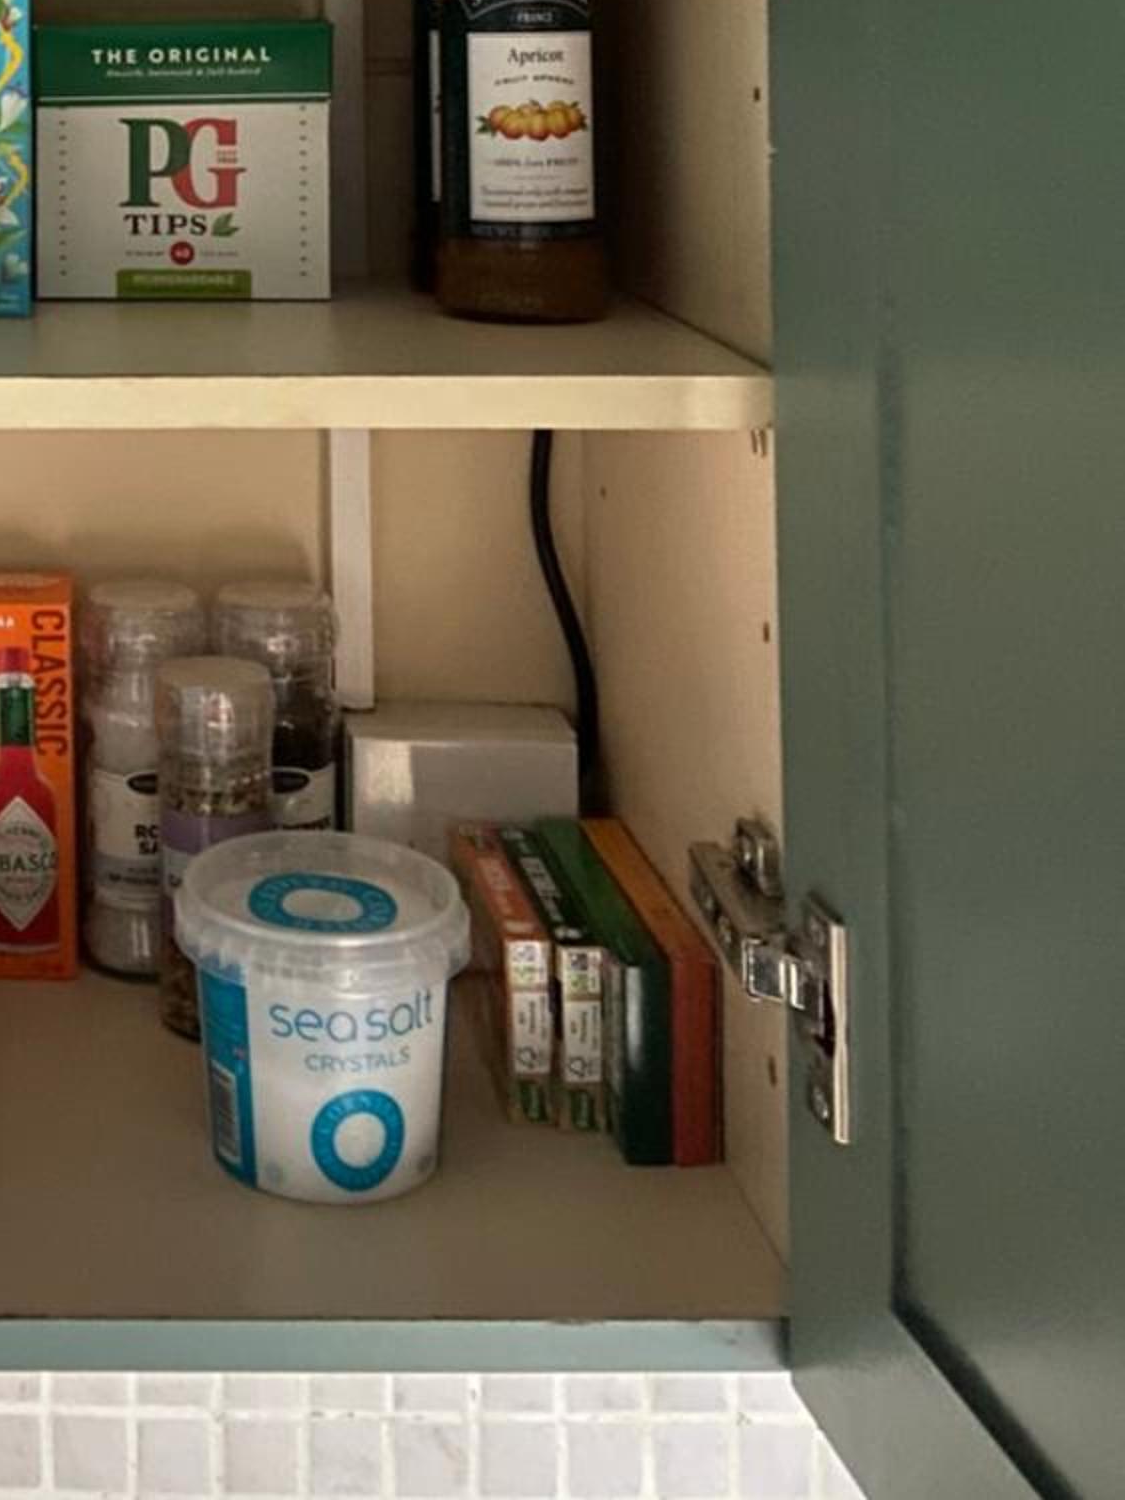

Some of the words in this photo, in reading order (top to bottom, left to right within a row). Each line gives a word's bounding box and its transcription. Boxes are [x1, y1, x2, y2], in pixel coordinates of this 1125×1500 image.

[91, 49, 137, 64] THE
[148, 47, 272, 63] ORIGINAL
[507, 47, 564, 66] Apricot
[118, 117, 247, 210] PG
[123, 213, 207, 235] TIPS
[31, 609, 69, 757] CLASSIC
[269, 1004, 357, 1042] sea
[365, 990, 433, 1040] salt
[304, 1050, 410, 1072] CRYSTALS
